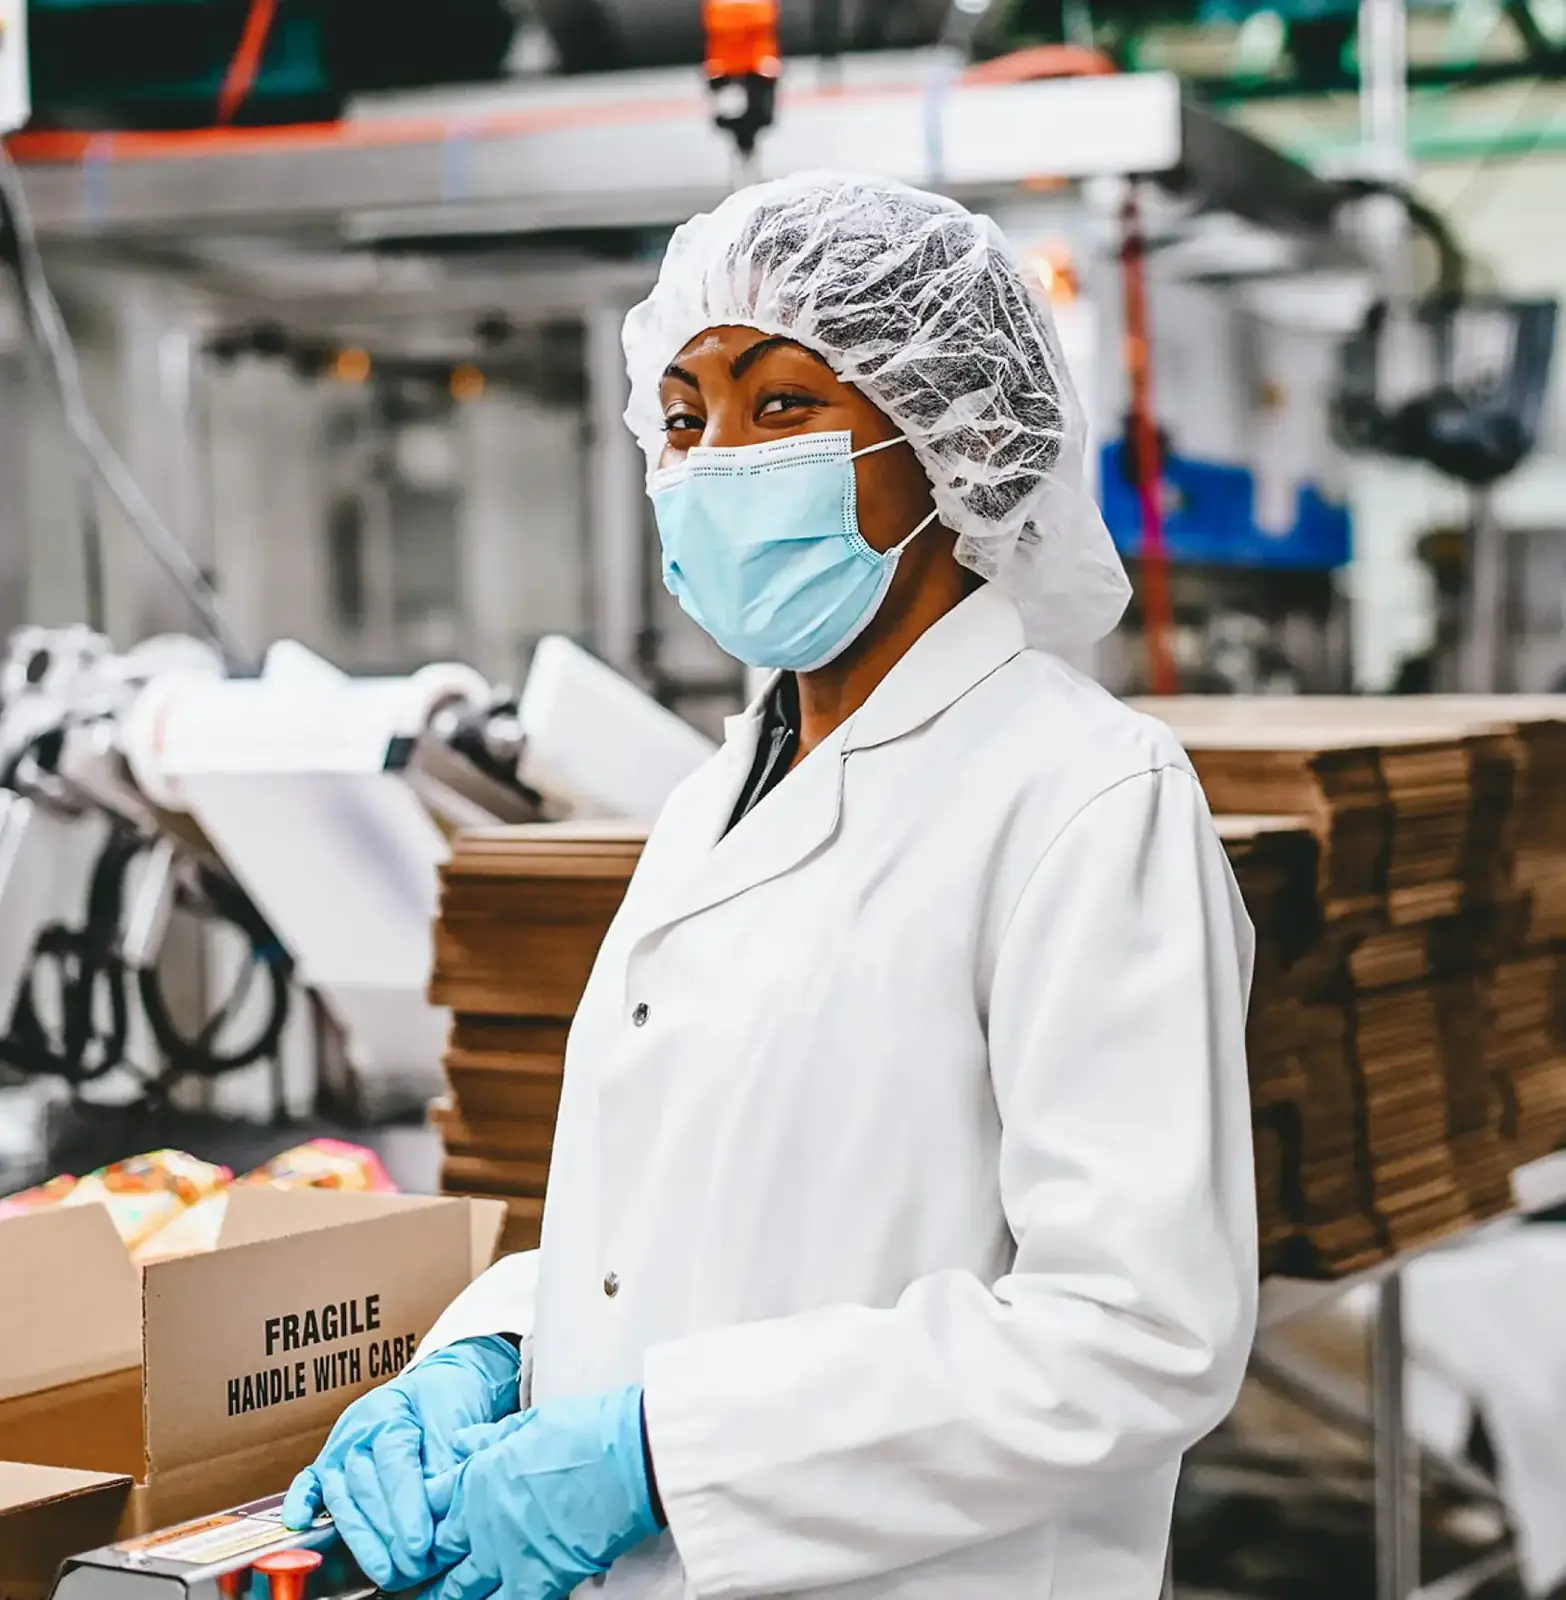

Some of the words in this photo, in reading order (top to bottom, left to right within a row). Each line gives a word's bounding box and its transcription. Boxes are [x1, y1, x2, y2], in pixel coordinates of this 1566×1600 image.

[265, 1294, 381, 1356] FRAGILE
[227, 1362, 306, 1416] HANDLE
[313, 1347, 361, 1393] WITH
[368, 1333, 416, 1378] CARE
